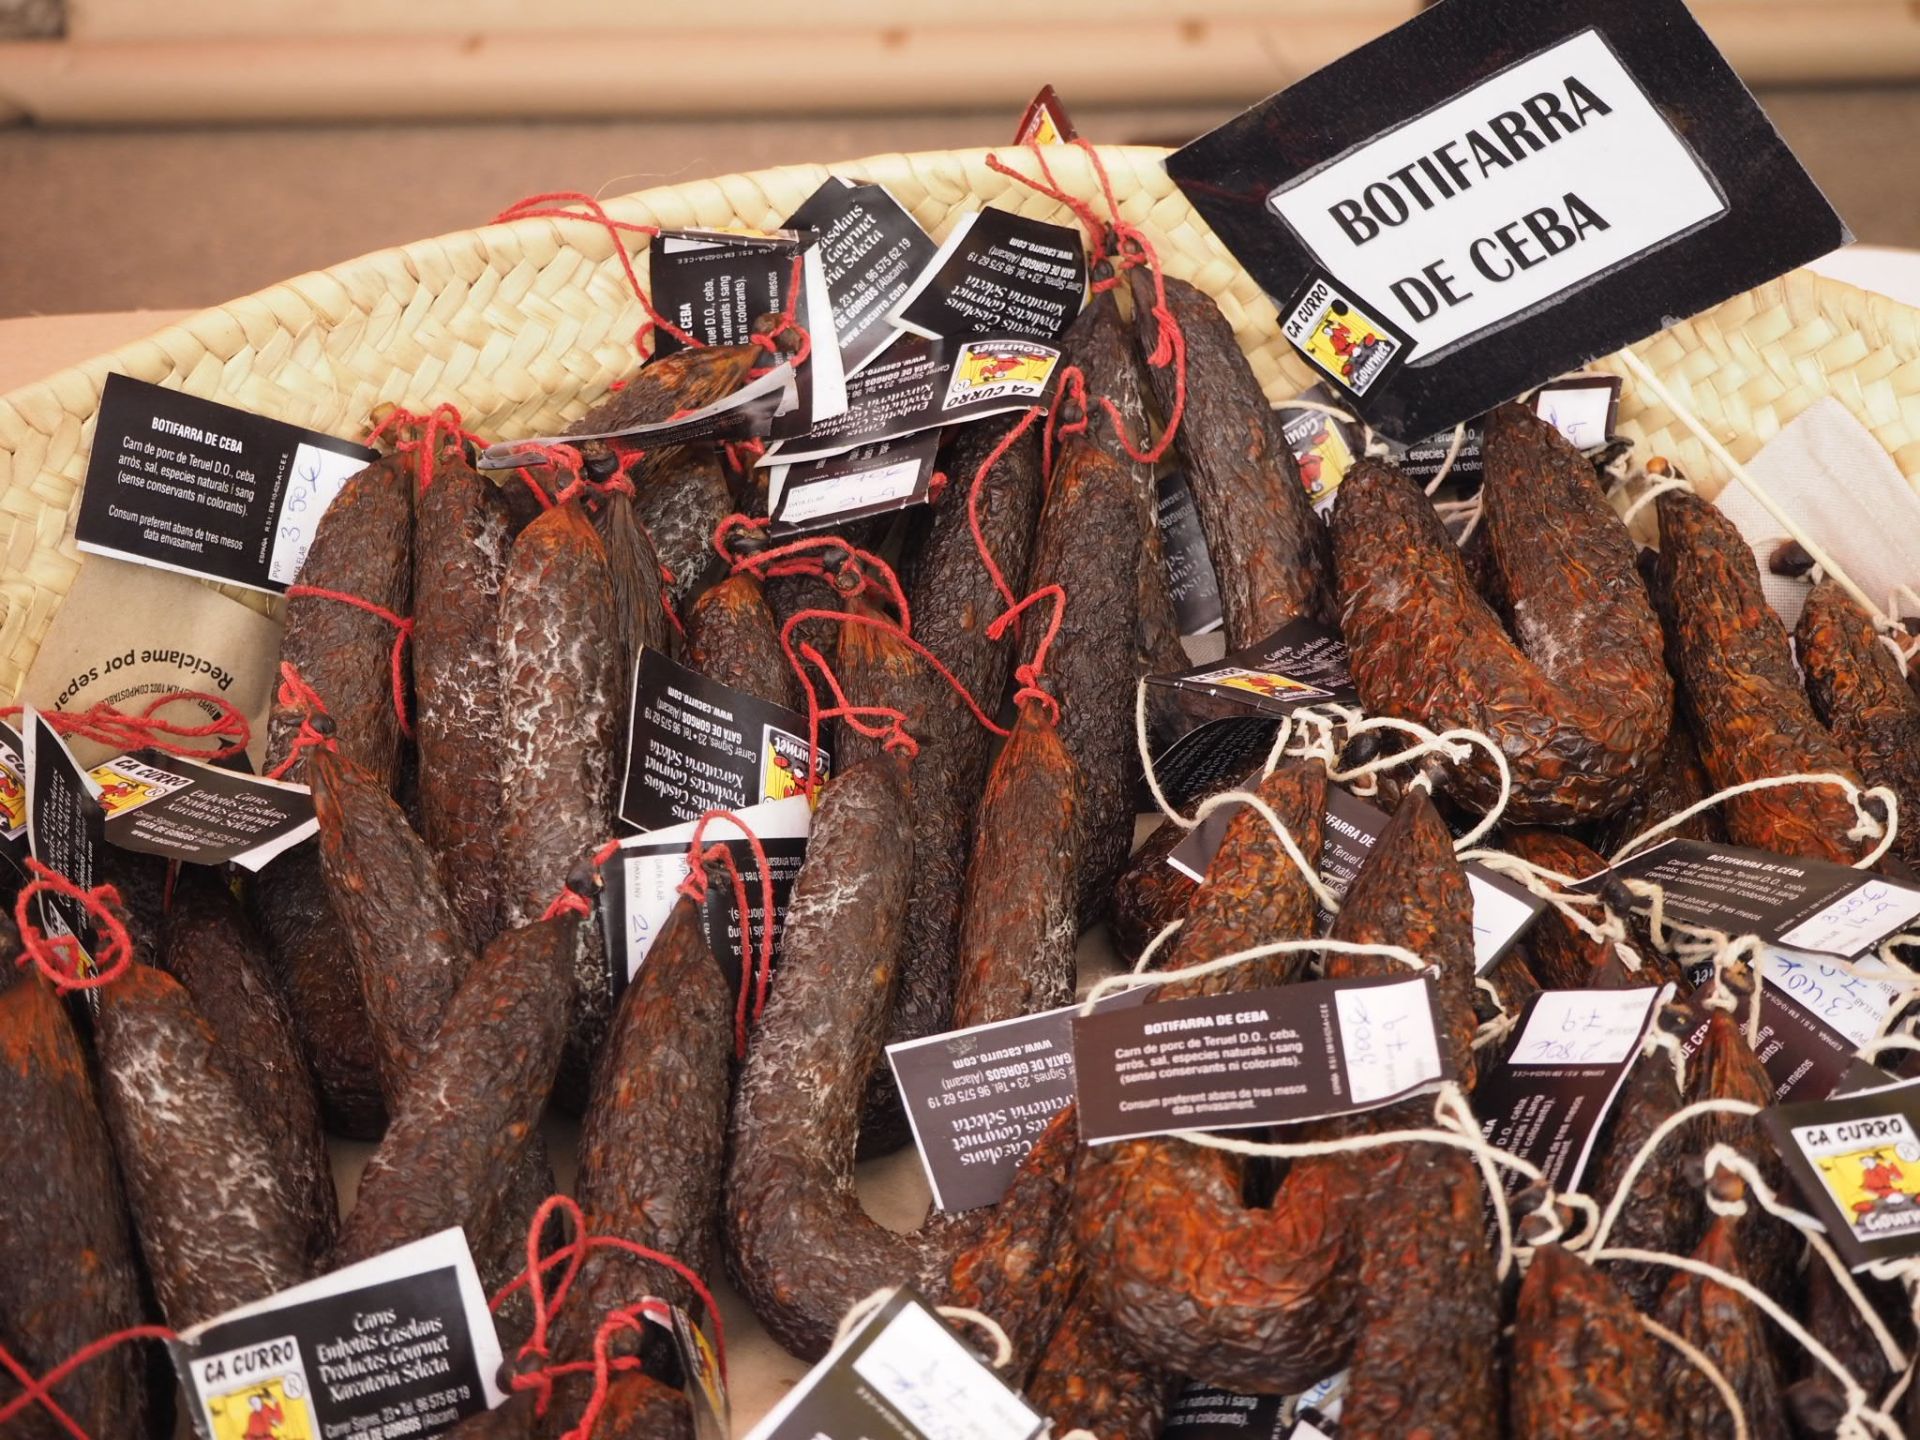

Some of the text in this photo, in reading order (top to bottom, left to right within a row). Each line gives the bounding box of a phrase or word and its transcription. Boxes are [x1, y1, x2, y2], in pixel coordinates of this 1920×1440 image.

[1327, 76, 1613, 247] BOTIFARRA
[826, 213, 877, 263] Gourmet
[843, 230, 884, 269] Selecta
[840, 238, 911, 307] 23 Tel. 96 575 62 19
[1390, 192, 1611, 324] DE CEBA
[703, 278, 716, 302] ceba,
[720, 275, 731, 296] sang
[735, 276, 747, 333] ni colorants).
[769, 271, 779, 313] tres mesos
[836, 260, 909, 330] DE GORGOS (Alacant)
[680, 302, 692, 328] CEBA
[720, 305, 733, 339] naturals
[839, 282, 908, 349] www.cacurro.com
[1286, 283, 1329, 339] CA CURRO
[1353, 340, 1392, 388] Gourmet
[151, 416, 243, 454] BOTIFARRA DE CEBA
[118, 454, 256, 503] arròs, sal, especies naturals i sang
[122, 436, 143, 452] Carn
[144, 441, 155, 456] de
[156, 446, 175, 463] porc
[176, 450, 187, 464] de
[189, 453, 213, 471] Teruel
[235, 466, 257, 485] ceba,
[117, 472, 249, 517] (sense conservants ni colorants).
[108, 504, 244, 551] Consum preferent abans de tres mesos
[143, 528, 159, 543] data
[272, 561, 281, 579] PVP
[105, 650, 135, 674] por
[55, 667, 98, 711] separ
[667, 686, 734, 722] www.cacurro.com
[644, 707, 757, 764] Carrer 23 Tel. 96 575 62 19
[656, 697, 742, 745] GATA DE GORGOS (Alacant)
[645, 755, 746, 808] Productes Gourmet
[650, 739, 744, 789] Xarcuteria Selecta
[644, 774, 689, 804] Casolans
[1332, 844, 1360, 865] Teruel
[1359, 833, 1376, 848] DE
[1144, 1009, 1269, 1036] BOTIFARRA DE CEBA
[952, 1039, 1053, 1069] www.cacurro.com
[1115, 1046, 1141, 1060] Carn
[1143, 1043, 1158, 1055] de
[1159, 1039, 1184, 1056] porc
[1187, 1038, 1201, 1050] de
[1202, 1032, 1237, 1048] Teruel
[1269, 1028, 1300, 1042] ceba,
[1150, 1055, 1169, 1068] sal,
[1172, 1049, 1220, 1068] especies
[1222, 1044, 1267, 1058] naturals
[1268, 1043, 1274, 1054] i
[1275, 1041, 1304, 1056] sang
[941, 1052, 1072, 1091] GATA DE GORGOS (Alacant)
[1119, 1055, 1302, 1087] (sense conservants ni colorants).
[1787, 1058, 1814, 1090] mesos
[927, 1077, 1031, 1109] 23 Tel. 96 575 62 19
[1119, 1083, 1308, 1113] Consum preferent abans de tres mesos
[1172, 1102, 1193, 1116] data
[952, 1108, 1009, 1132] Selecta
[952, 1124, 1022, 1151] Gourmet
[1806, 1119, 1903, 1146] CA CURRO
[960, 1138, 1033, 1166] Casolans
[353, 1308, 397, 1333] Carns
[316, 1317, 444, 1366] Embotits Casolans
[318, 1334, 451, 1385] Productes Gourmet
[204, 1341, 295, 1384] CA CURRO
[329, 1356, 450, 1405] Xarcuteria Selecta
